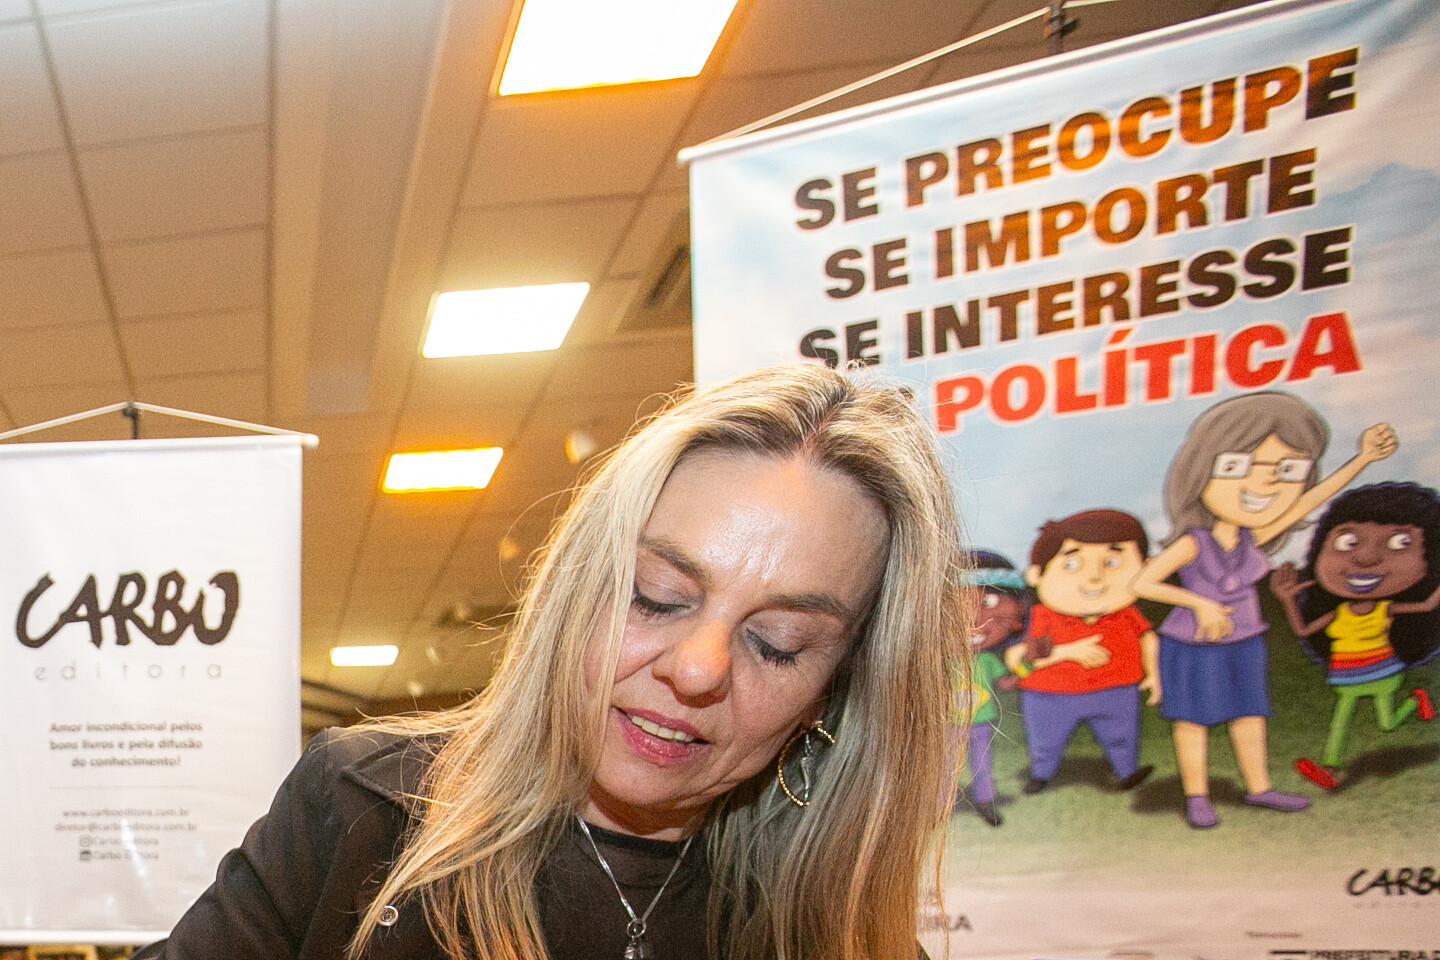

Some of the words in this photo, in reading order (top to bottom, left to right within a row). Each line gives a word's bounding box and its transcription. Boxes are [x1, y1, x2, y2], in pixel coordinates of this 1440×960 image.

[795, 167, 879, 230] SE
[905, 48, 1359, 208] PREOCUPE
[825, 238, 910, 299] SE
[935, 148, 1317, 279] IMPORTE
[906, 228, 1352, 359] INTERESSE
[935, 312, 1362, 433] POLÍTICA
[16, 570, 240, 649] CARBO
[34, 661, 222, 681] editora
[50, 722, 82, 733] Amor
[86, 721, 167, 732] incondicional
[170, 722, 203, 734] pelos
[50, 739, 78, 750] bons
[82, 738, 114, 749] livros
[118, 741, 125, 749] e
[128, 739, 154, 751] pela
[158, 738, 203, 749] difusão
[71, 757, 87, 767] do
[90, 756, 182, 767] conhecimento!
[1346, 867, 1440, 896] CARB
